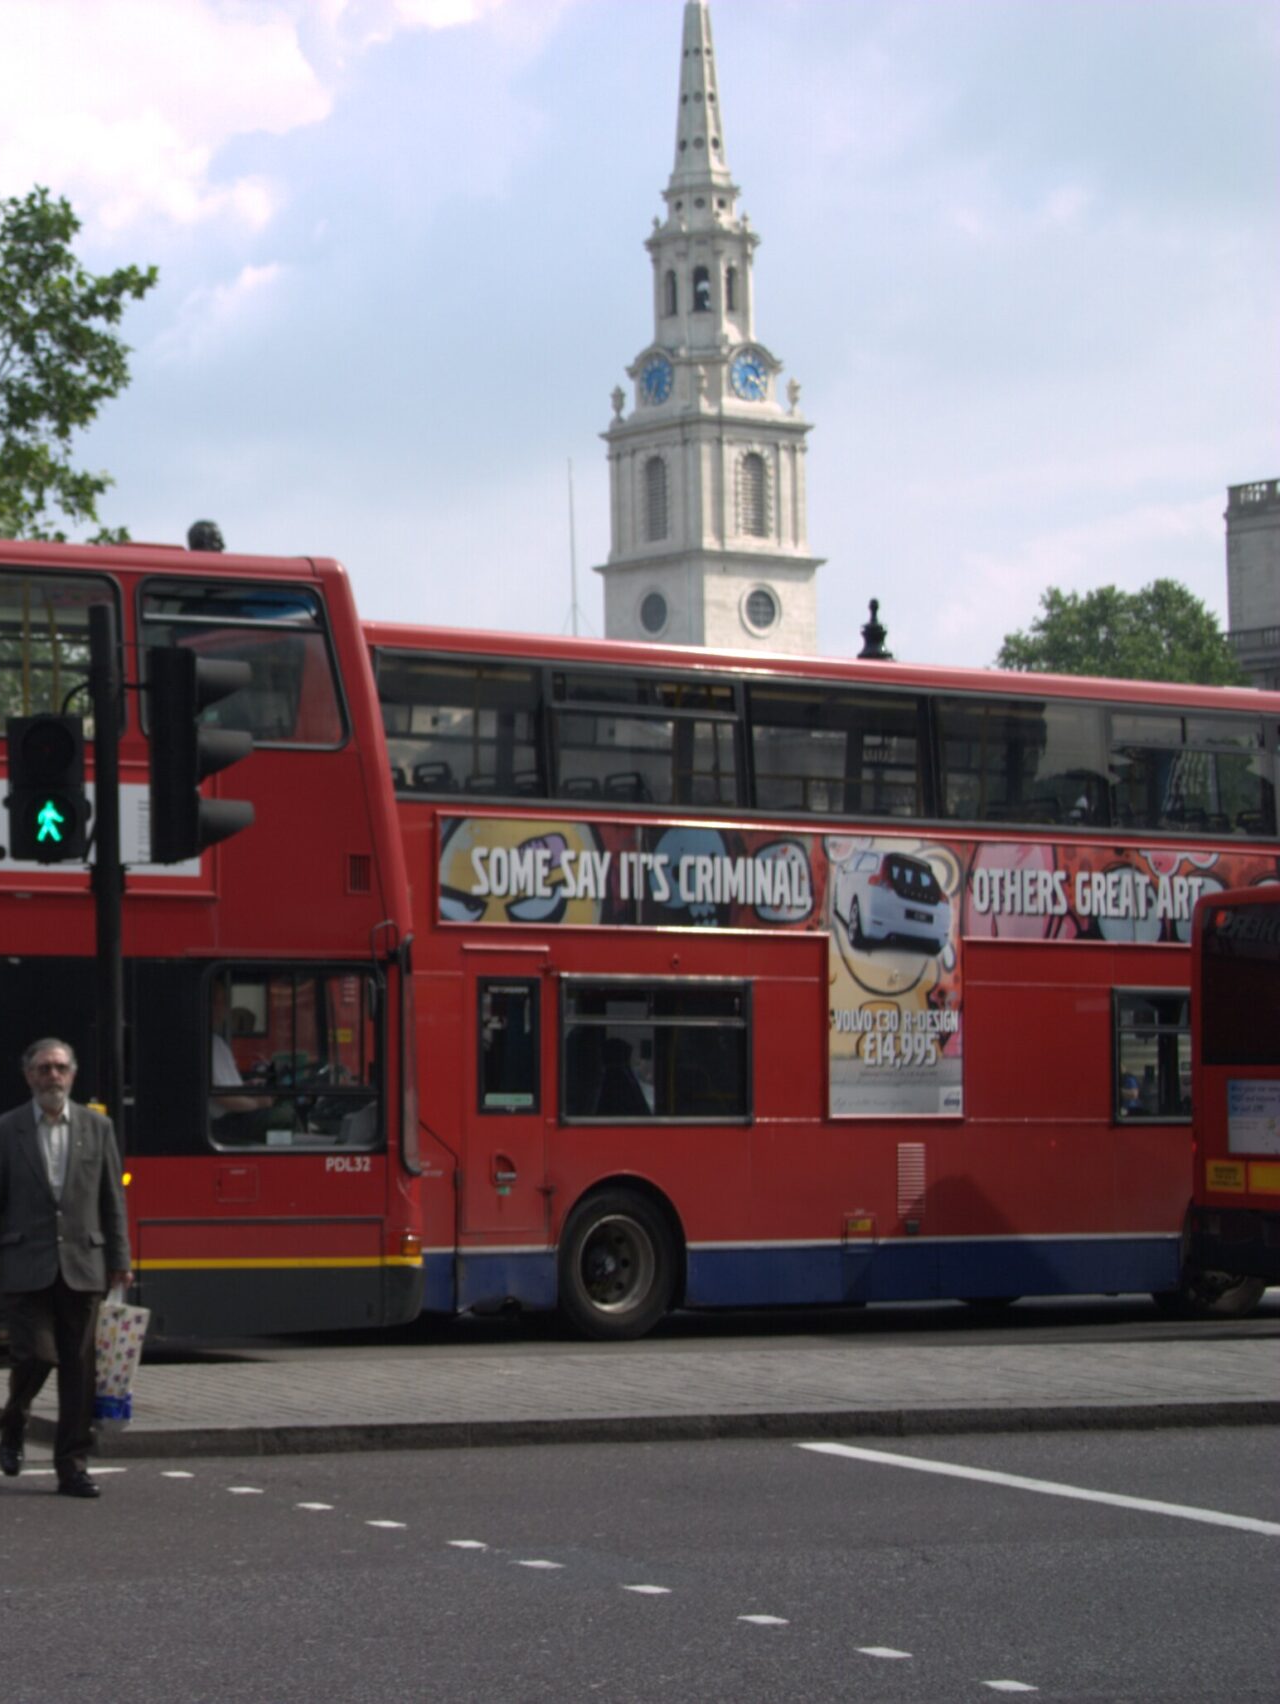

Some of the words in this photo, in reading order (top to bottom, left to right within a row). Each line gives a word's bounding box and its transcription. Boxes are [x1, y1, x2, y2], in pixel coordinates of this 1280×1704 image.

[470, 846, 554, 898] SOME
[560, 850, 612, 900] SAY
[619, 852, 670, 902] IT'S
[678, 855, 809, 906] CRIMINAL
[972, 867, 1068, 916] OTHERS
[1074, 871, 1150, 919] GREAT
[1156, 875, 1204, 920] ART
[835, 1009, 873, 1032] VOLVO
[875, 1009, 899, 1032] C30
[904, 1009, 959, 1033] R-DESIGN
[864, 1031, 938, 1070] £14,995
[325, 1156, 372, 1173] PDL32
